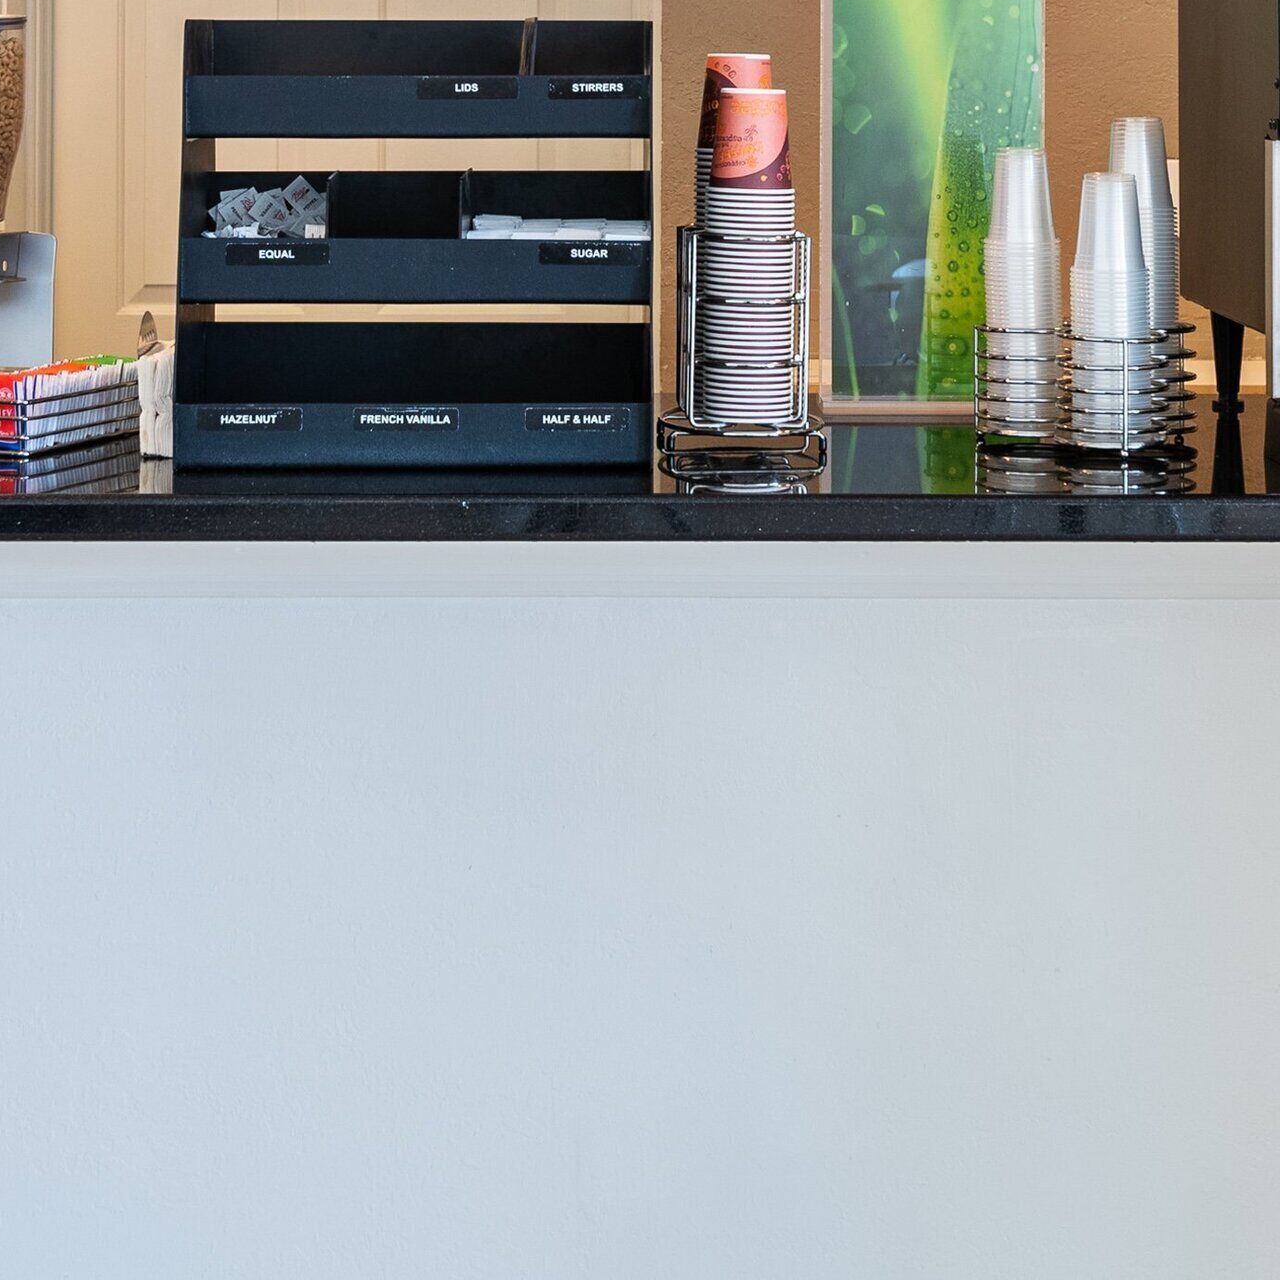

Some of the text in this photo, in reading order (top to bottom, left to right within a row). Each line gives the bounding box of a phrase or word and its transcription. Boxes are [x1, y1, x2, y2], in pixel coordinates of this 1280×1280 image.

[454, 83, 479, 93] LIDS
[571, 83, 624, 93] STIRRERS
[258, 249, 295, 259] EQUAL
[570, 248, 609, 258] SUGAR
[220, 414, 278, 424] HAZELNUT
[360, 414, 451, 424] FRENCH VANILLA
[542, 414, 612, 424] HALF & HALF
